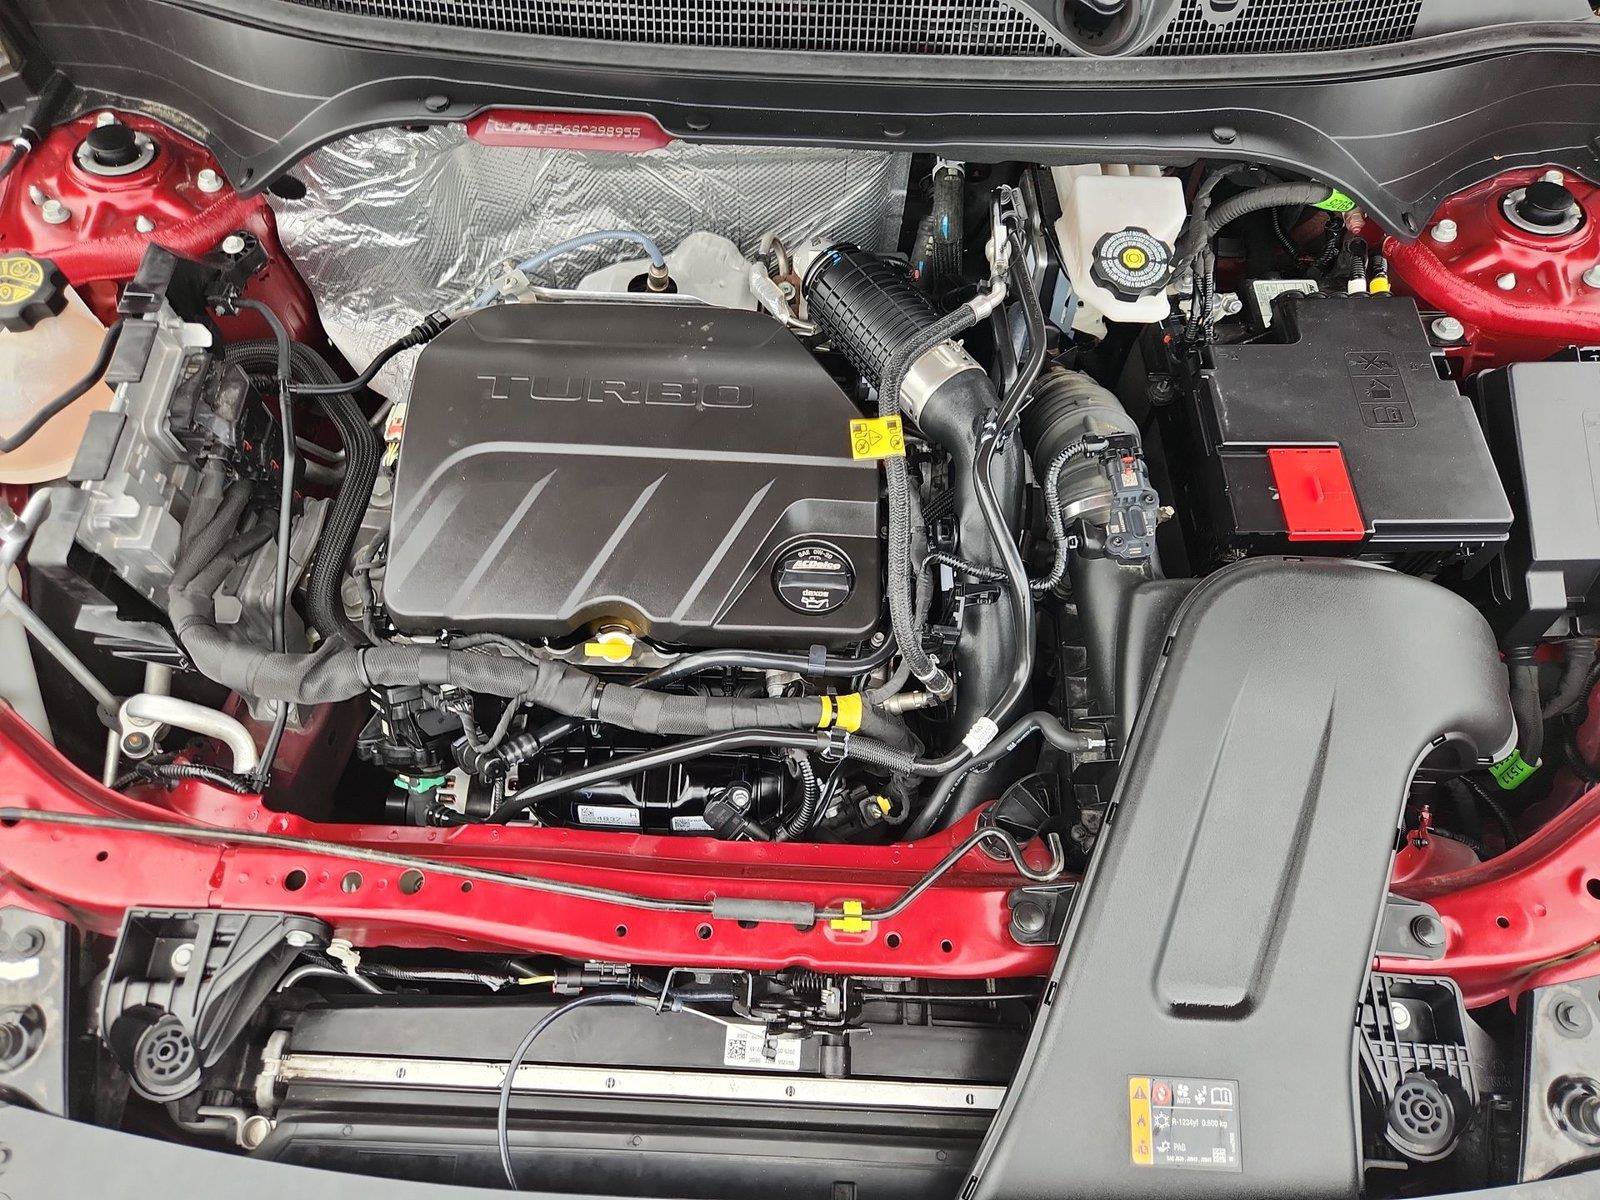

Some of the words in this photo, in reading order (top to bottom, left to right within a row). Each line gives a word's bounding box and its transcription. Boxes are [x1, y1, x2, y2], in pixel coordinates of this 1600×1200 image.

[494, 118, 641, 138] LLFEP6SC298955
[477, 375, 755, 409] TURBO
[792, 560, 841, 571] ACDelco
[802, 588, 830, 598] dexos
[1501, 764, 1524, 785] 1511
[1219, 1119, 1228, 1129] kg
